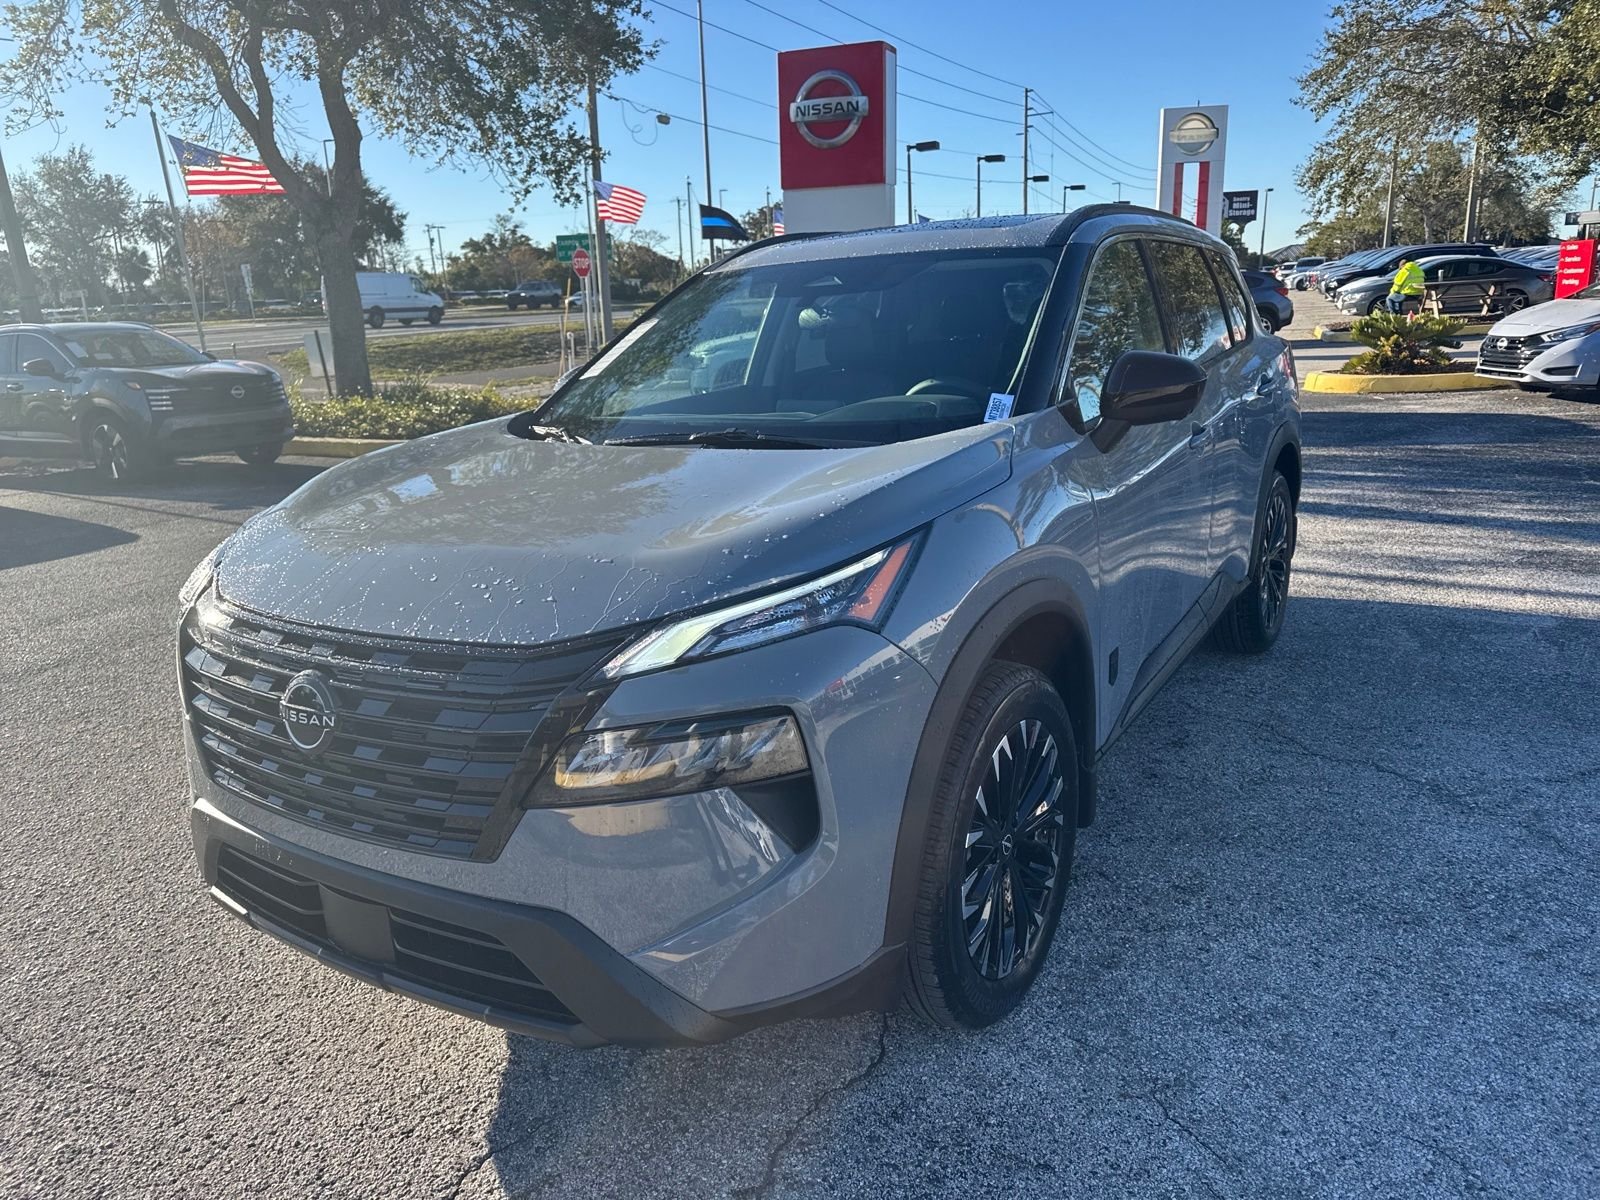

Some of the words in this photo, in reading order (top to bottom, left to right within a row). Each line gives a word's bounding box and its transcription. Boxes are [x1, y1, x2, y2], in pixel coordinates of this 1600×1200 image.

[796, 100, 859, 117] NISSAN
[1228, 209, 1255, 217] Storage
[574, 258, 590, 269] STOP
